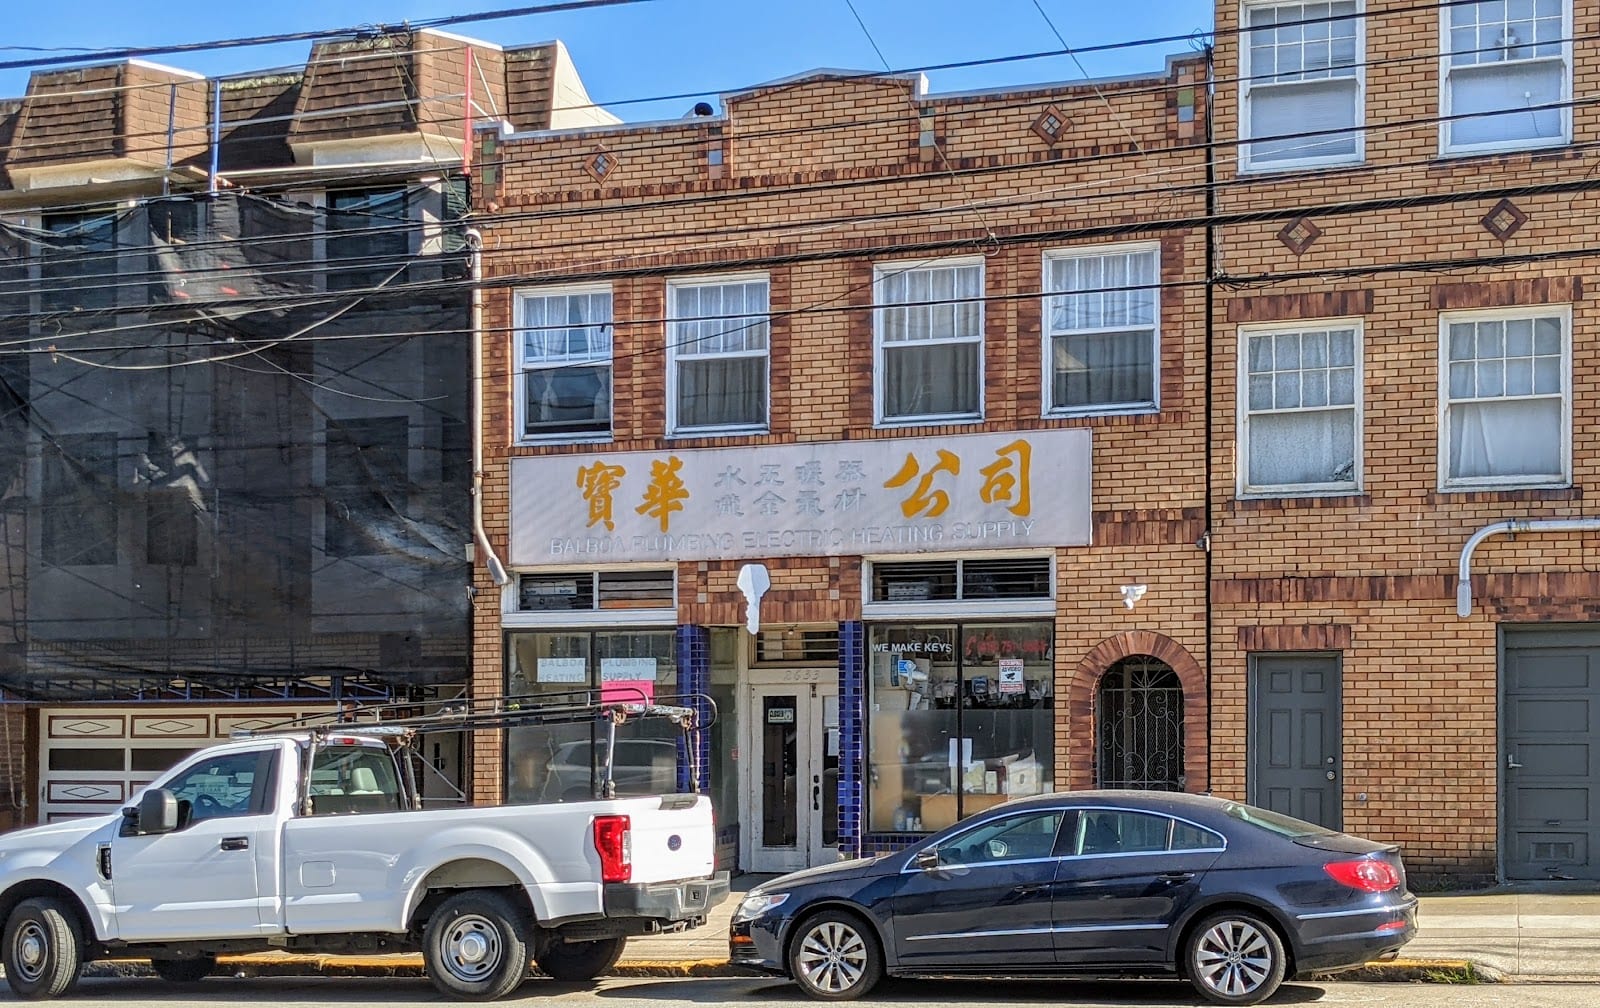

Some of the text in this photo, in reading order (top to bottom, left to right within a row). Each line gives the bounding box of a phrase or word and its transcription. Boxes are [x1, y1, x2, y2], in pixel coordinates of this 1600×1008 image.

[576, 439, 1032, 533] 寶華 公司
[550, 519, 1035, 556] BALBOA PLUMBING ELECTRIC HEATING SUPPLY
[872, 642, 952, 653] WE MAKE KEYS
